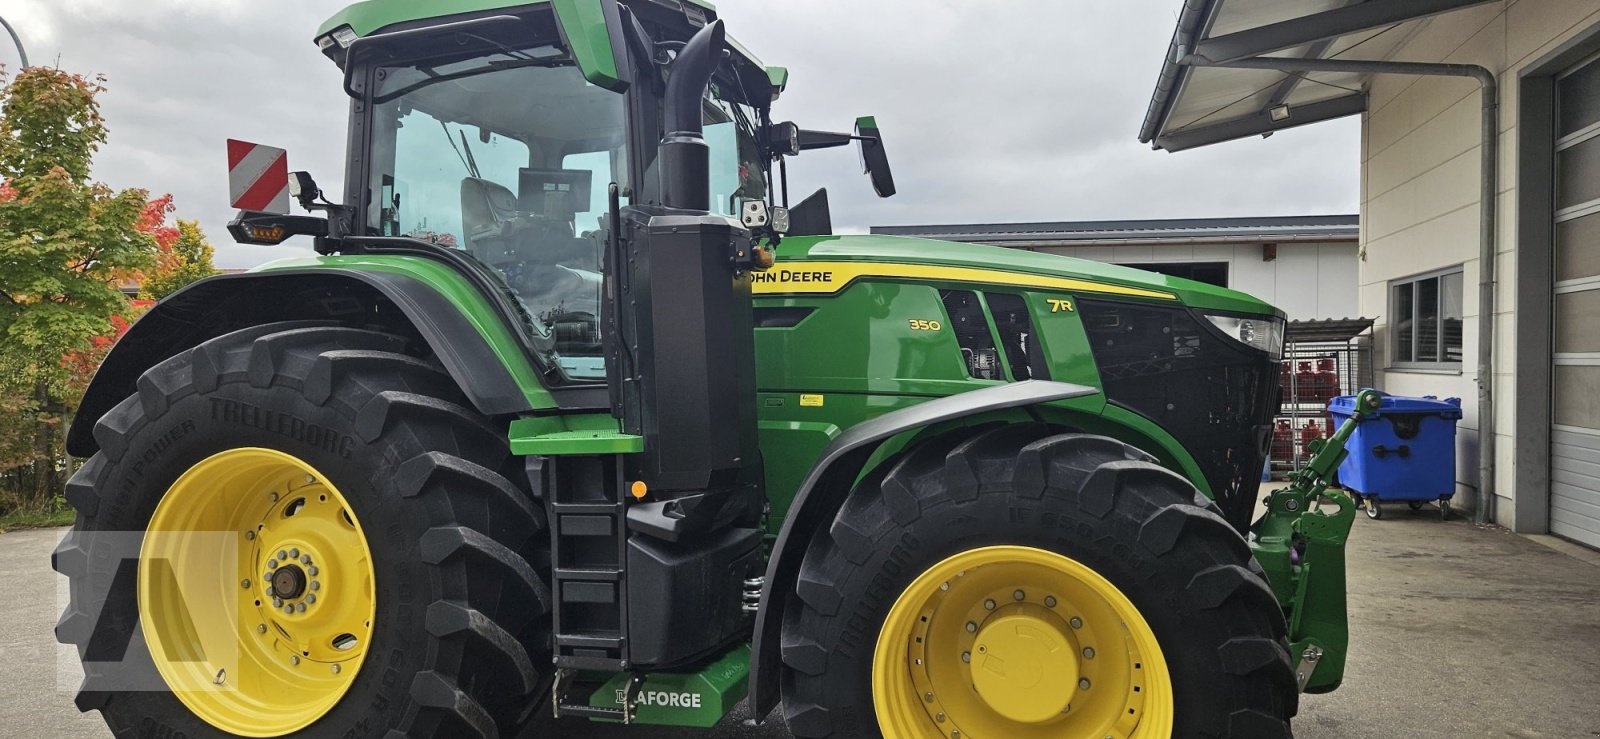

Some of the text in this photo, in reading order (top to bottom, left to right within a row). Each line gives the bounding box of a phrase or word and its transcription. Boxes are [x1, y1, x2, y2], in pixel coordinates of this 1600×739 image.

[780, 270, 833, 282] DEERE
[1046, 298, 1074, 313] 7R
[909, 319, 941, 331] 350
[637, 690, 701, 708] AFORGE
